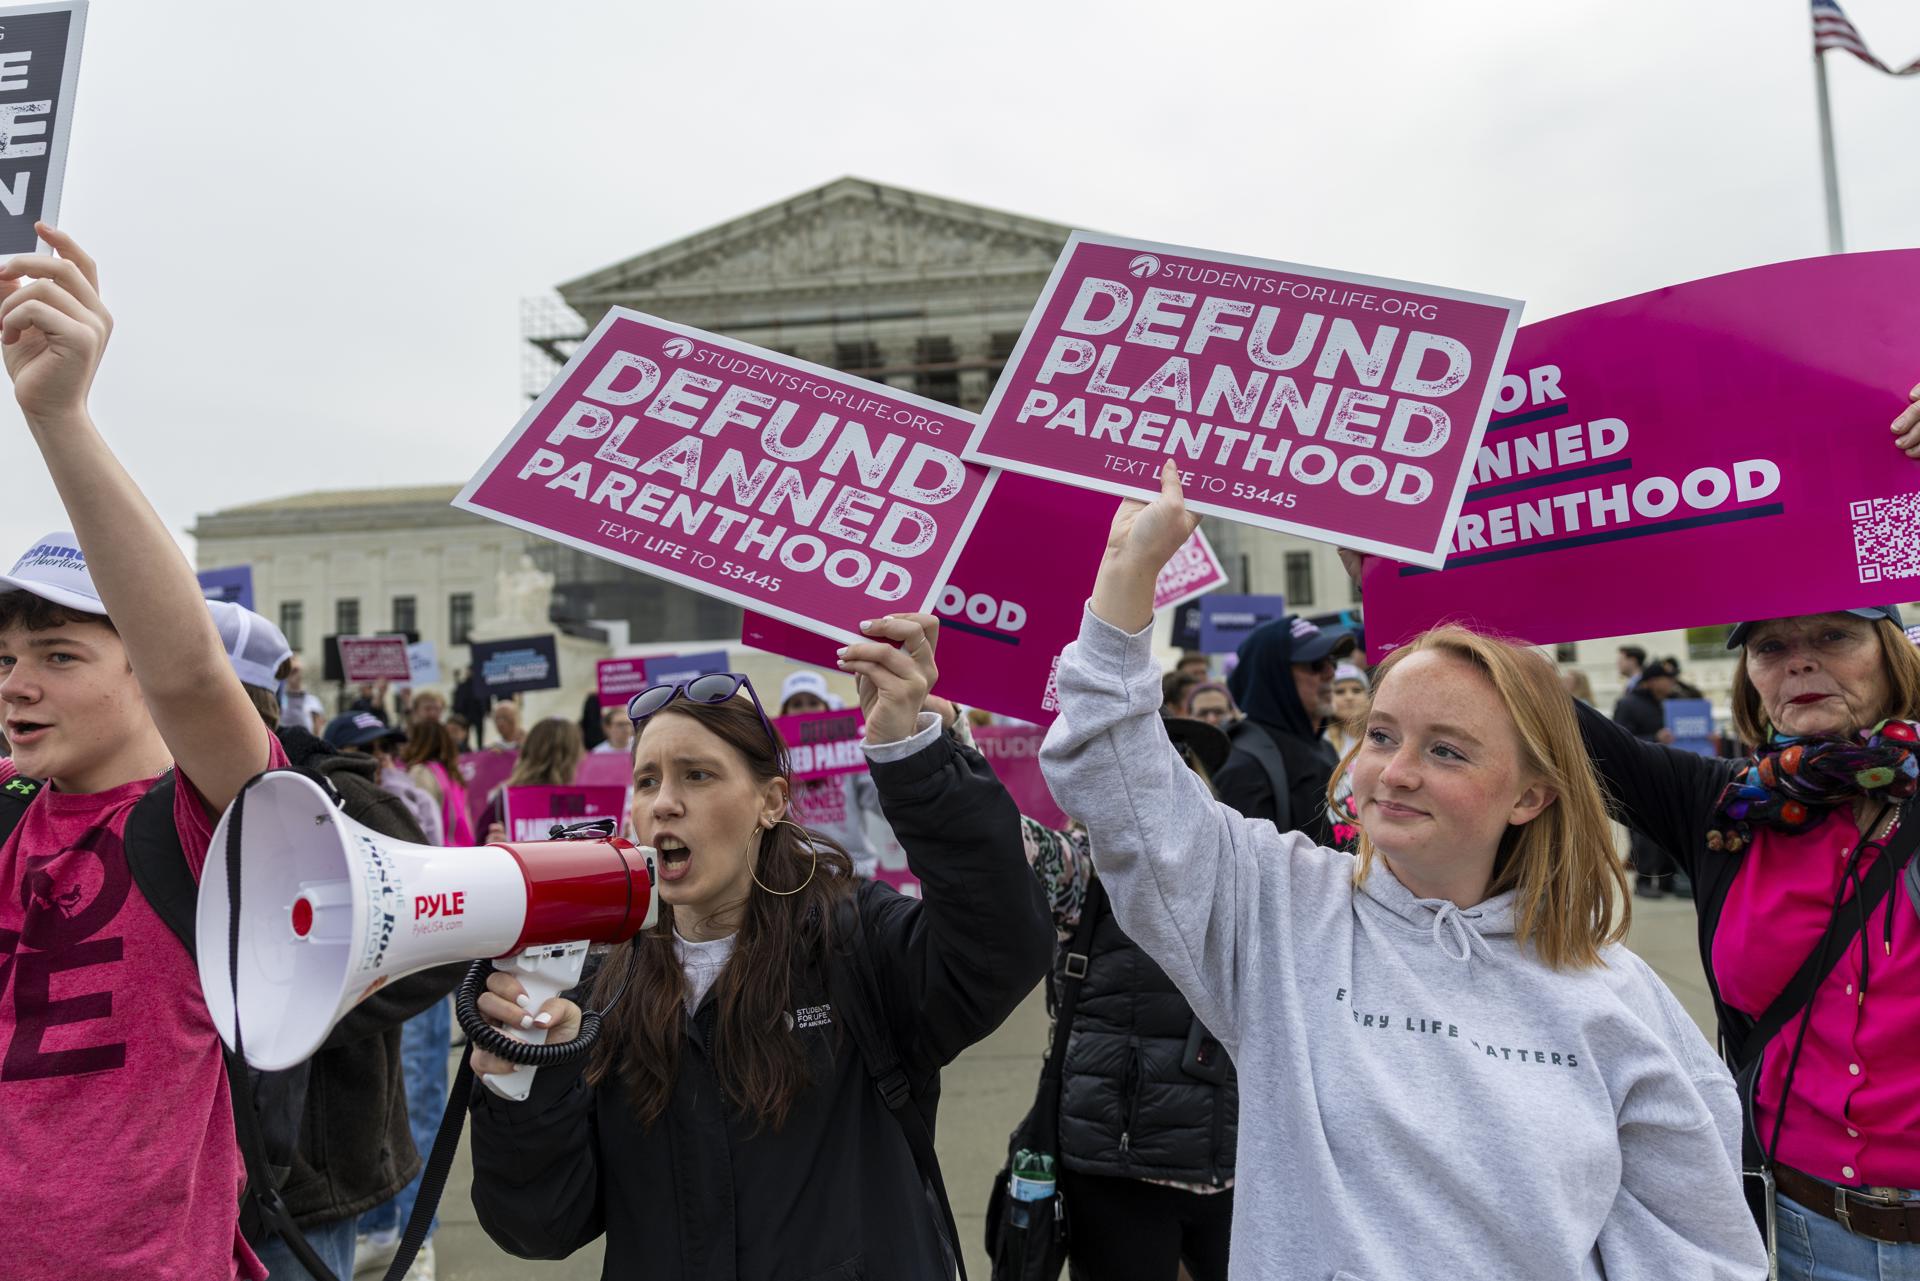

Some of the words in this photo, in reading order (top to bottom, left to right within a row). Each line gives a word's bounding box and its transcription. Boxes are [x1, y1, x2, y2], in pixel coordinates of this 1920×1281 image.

[1162, 263, 1438, 321] STUDENTSFORLIFE.ORG
[1060, 276, 1472, 398] DEFUND
[582, 349, 966, 505] DEFUND
[693, 349, 945, 436] STUDENTSFORLIFE.ORG
[1035, 335, 1451, 458] PLANNED
[545, 400, 938, 558] PLANNED
[1016, 389, 1434, 505] PARENTHOOD
[1104, 454, 1149, 476] TEXT
[1152, 466, 1195, 486] LE
[1201, 475, 1226, 493] TO
[1231, 482, 1297, 508] 53445
[1468, 417, 1630, 486] NNED
[517, 448, 913, 601] PARENTHOOD
[1447, 458, 1782, 555] RENTHOOD
[597, 520, 644, 544] TEXT
[644, 536, 688, 560] LIFE
[692, 550, 716, 569] TO
[719, 561, 782, 592] 53445
[415, 891, 464, 921] PYLE
[796, 1004, 831, 1016] STUDENTS
[797, 1014, 812, 1023] FOR
[813, 1011, 827, 1020] LIFE
[1336, 987, 1389, 1028] EERY
[1406, 1017, 1458, 1038] LIFE
[1470, 1038, 1578, 1067] ATTERS
